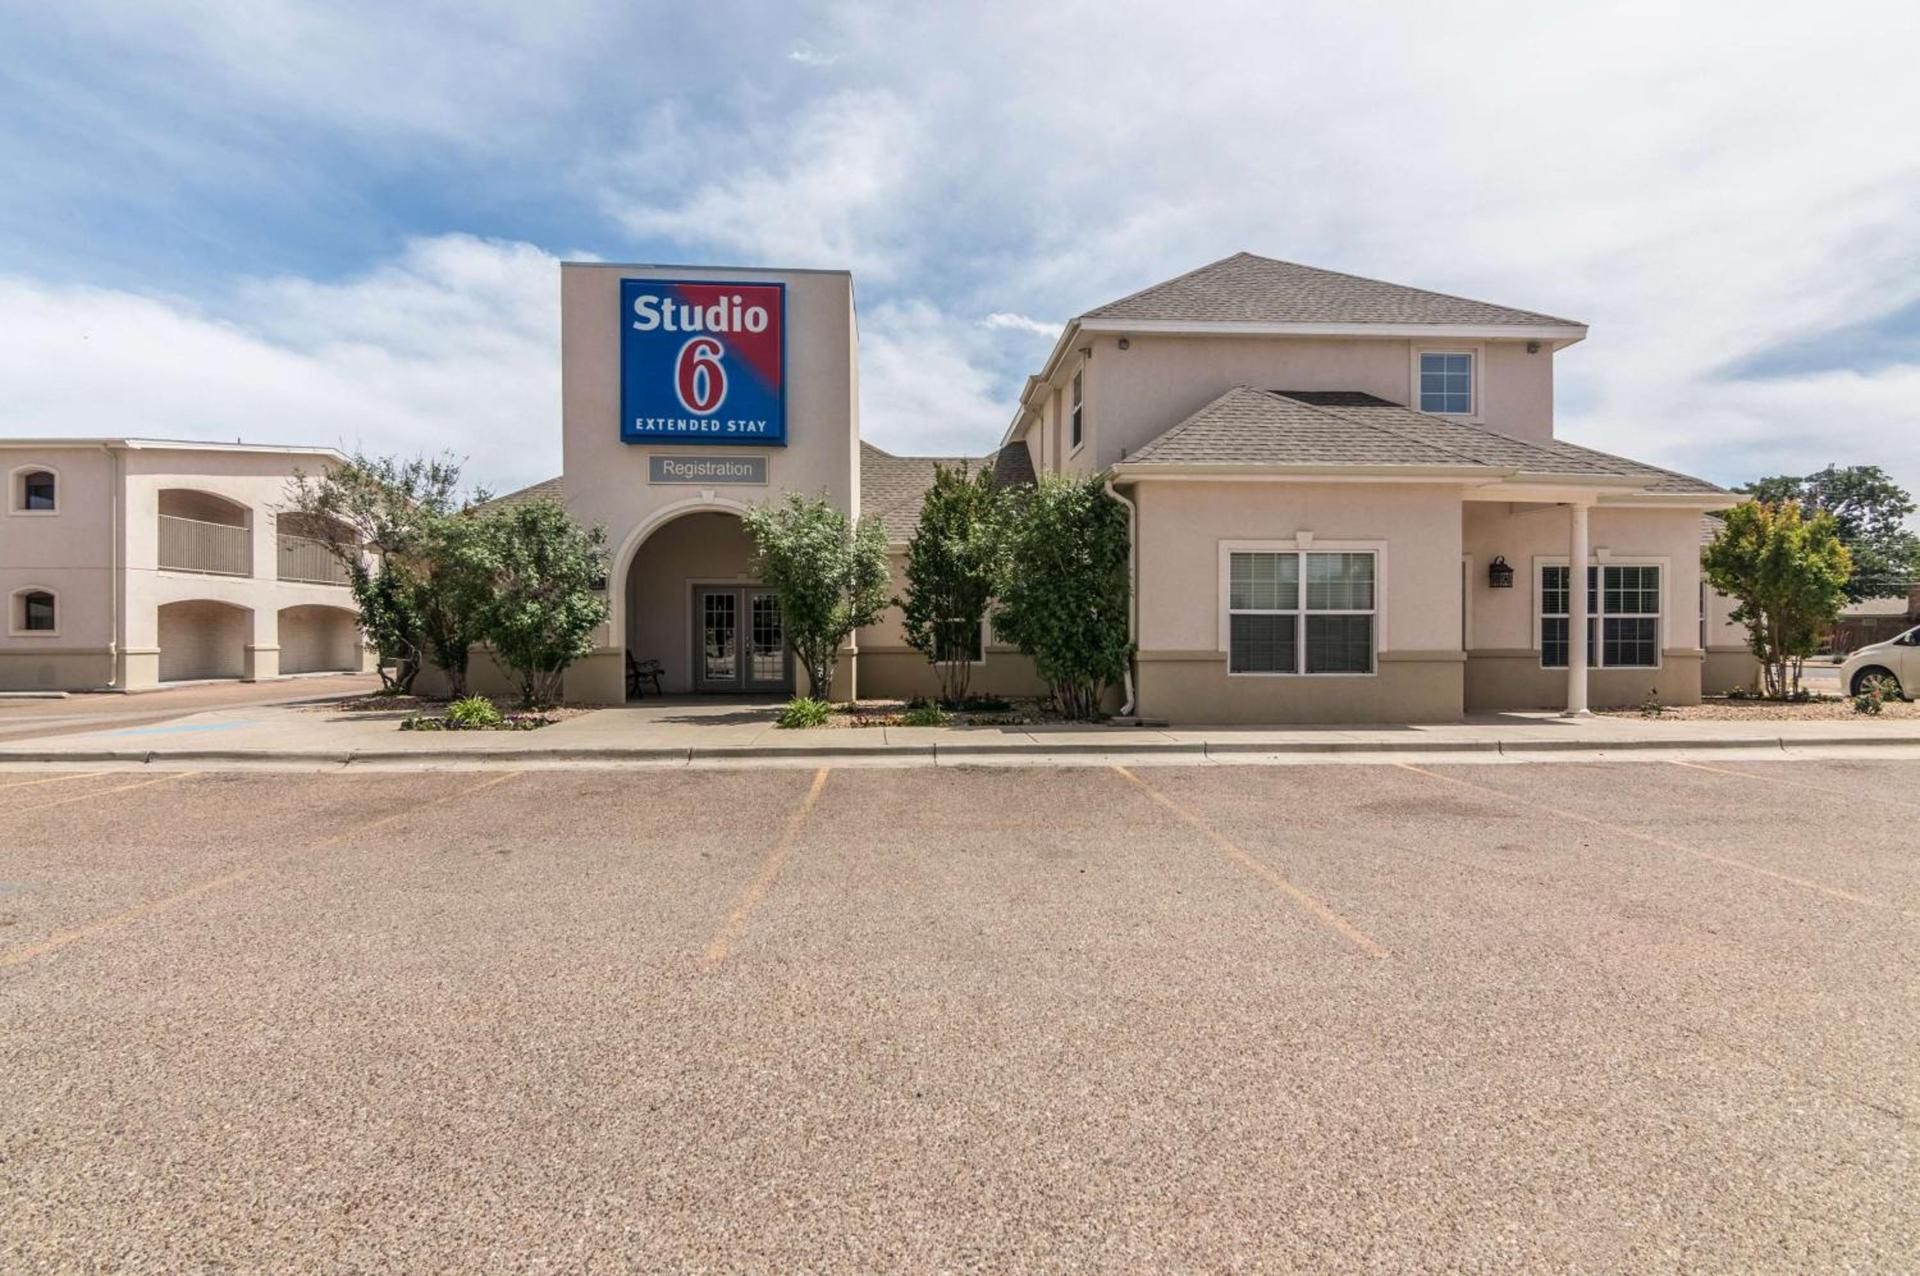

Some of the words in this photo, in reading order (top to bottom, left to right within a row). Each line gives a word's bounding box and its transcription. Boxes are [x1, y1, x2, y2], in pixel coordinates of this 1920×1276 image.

[632, 294, 769, 333] Studio
[674, 335, 728, 416] 6
[635, 418, 721, 432] EXTENDED
[726, 420, 767, 433] STAY
[663, 459, 753, 478] Registration
